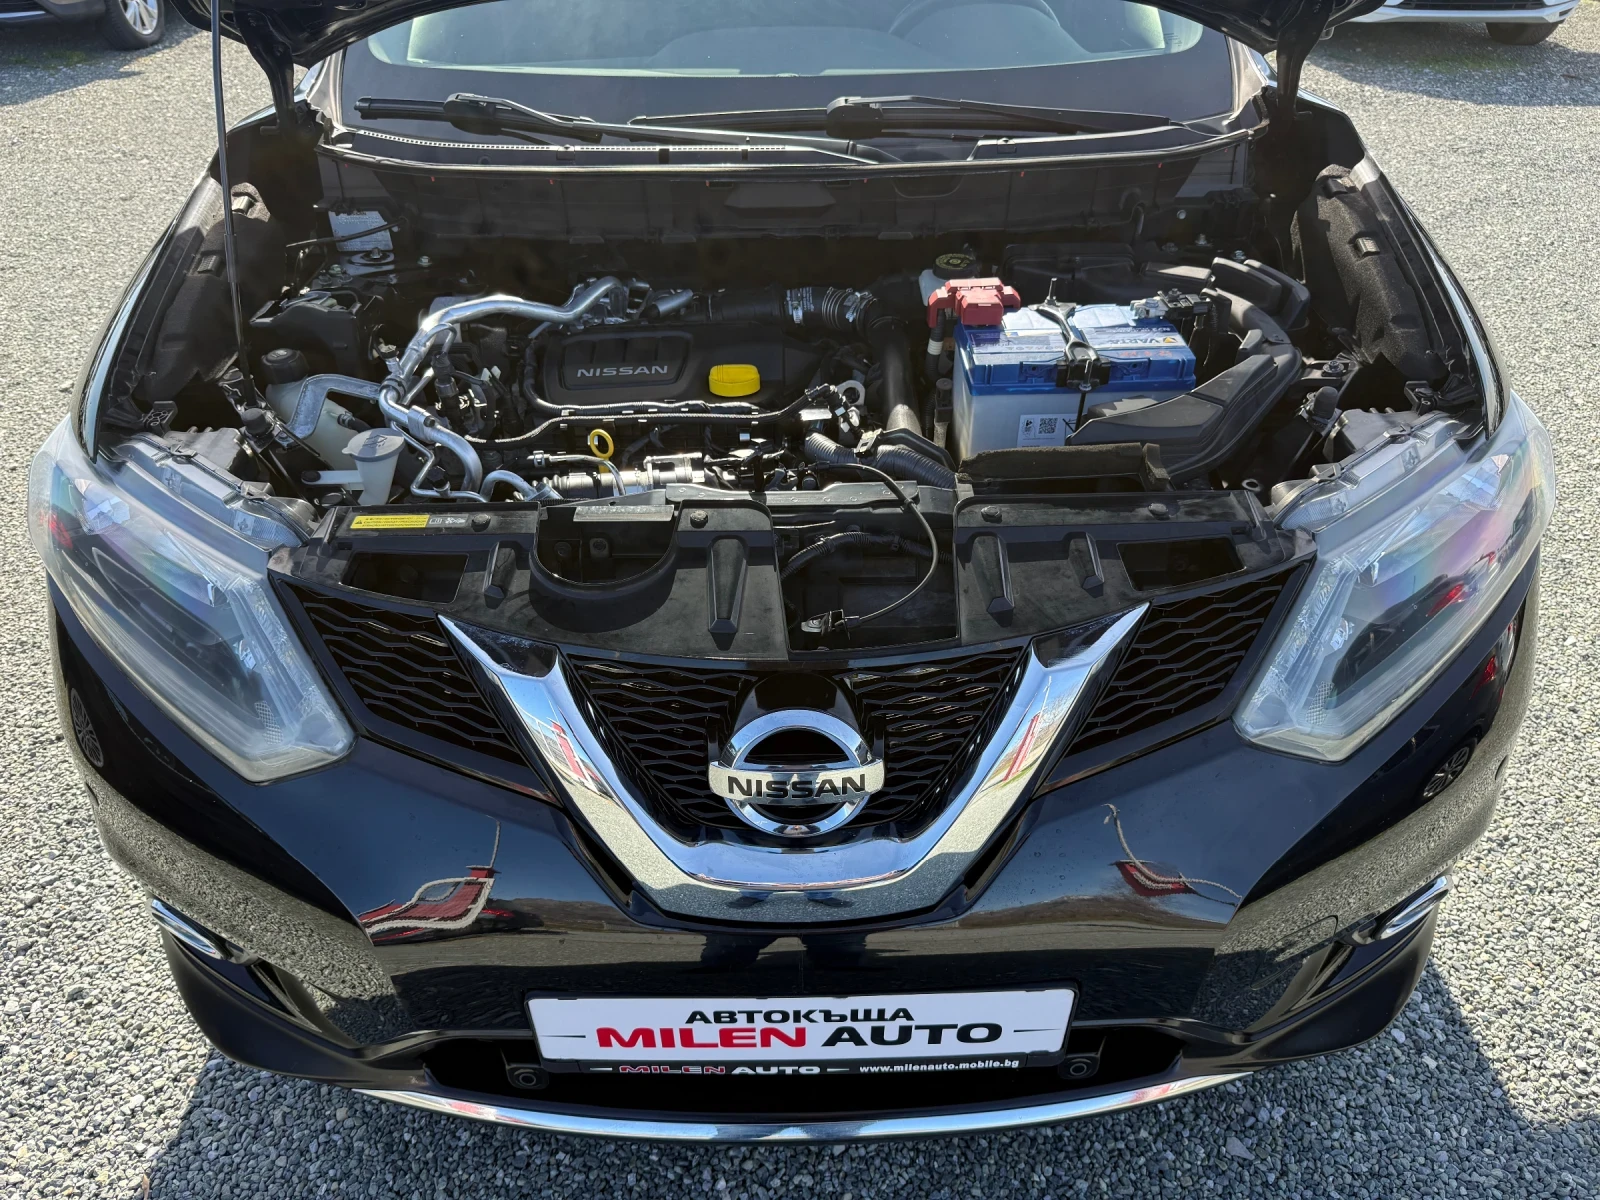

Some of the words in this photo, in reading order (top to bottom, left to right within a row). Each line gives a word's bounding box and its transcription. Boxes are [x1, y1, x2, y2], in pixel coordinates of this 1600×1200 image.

[577, 365, 668, 377] NISSAN
[727, 773, 866, 798] NISSAN
[596, 1027, 806, 1048] MILEN
[821, 1022, 1003, 1047] AUTO
[619, 1065, 726, 1074] MILEN
[731, 1065, 821, 1075] AUTO
[859, 1059, 1019, 1073] www.milenauto.mobile.bg
